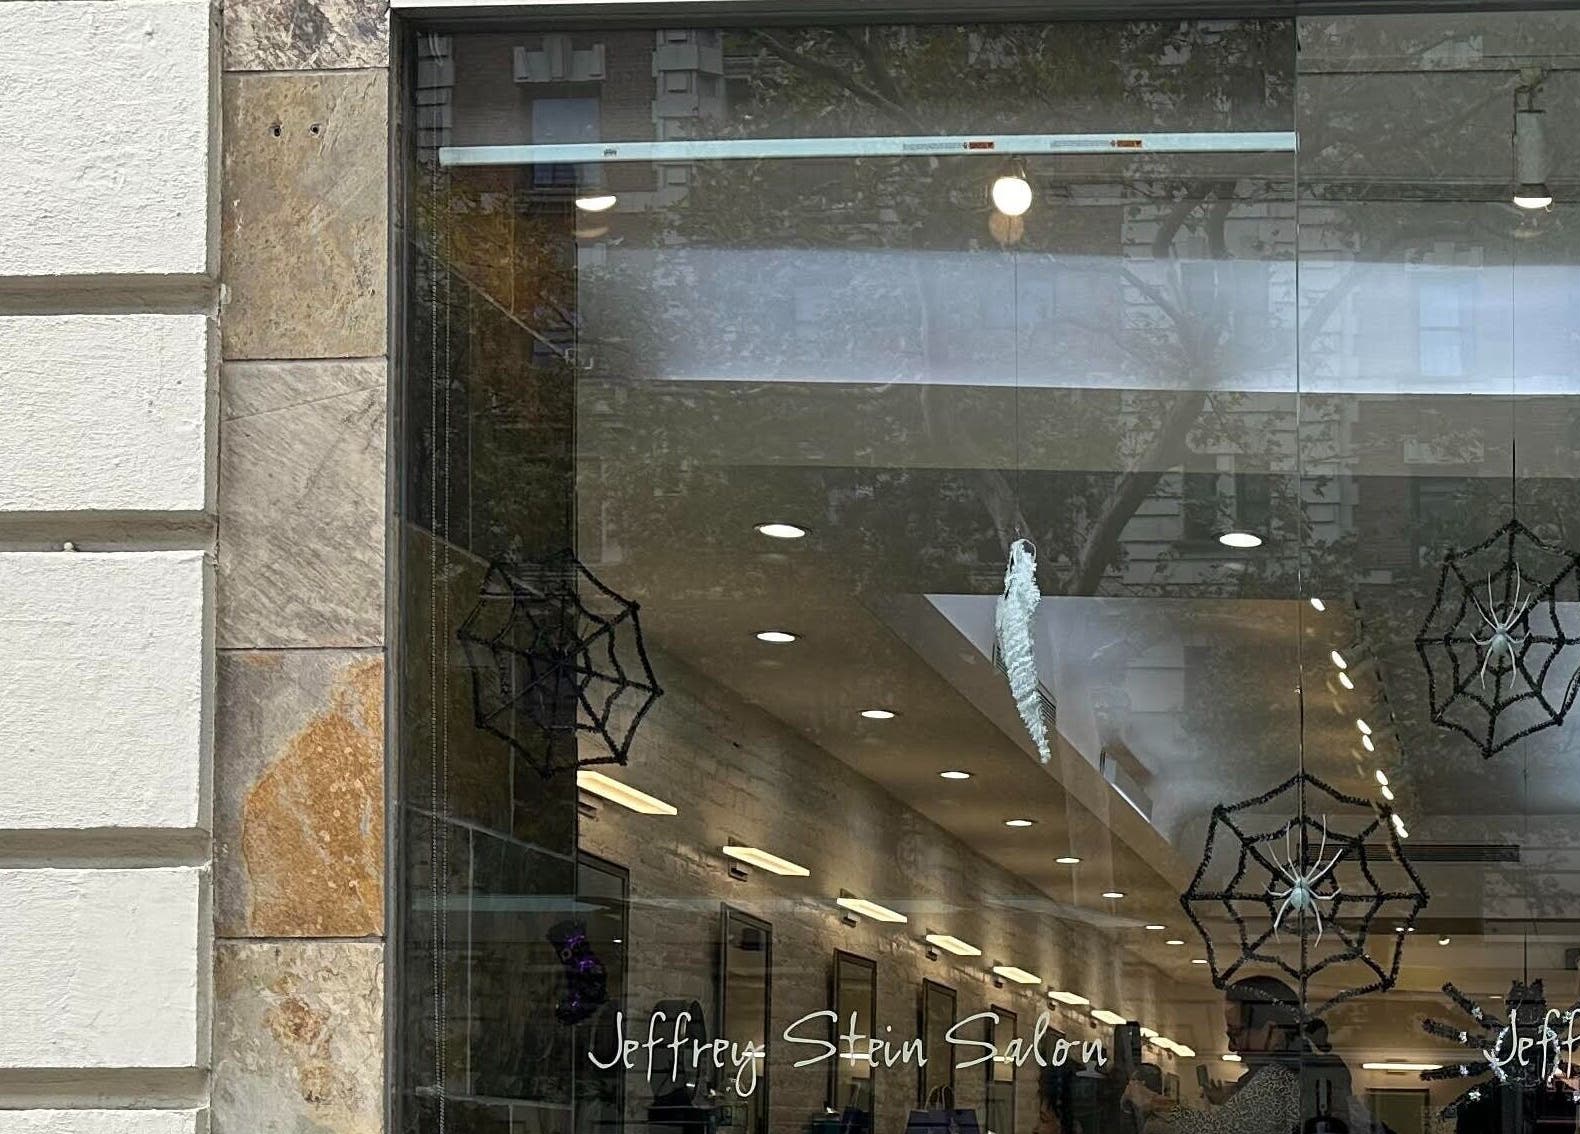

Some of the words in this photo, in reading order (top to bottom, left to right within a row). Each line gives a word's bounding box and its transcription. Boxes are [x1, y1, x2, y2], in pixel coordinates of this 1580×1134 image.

[588, 1011, 766, 1098] Jeffrey
[783, 1010, 929, 1068] Stein
[945, 1010, 1109, 1068] Salon
